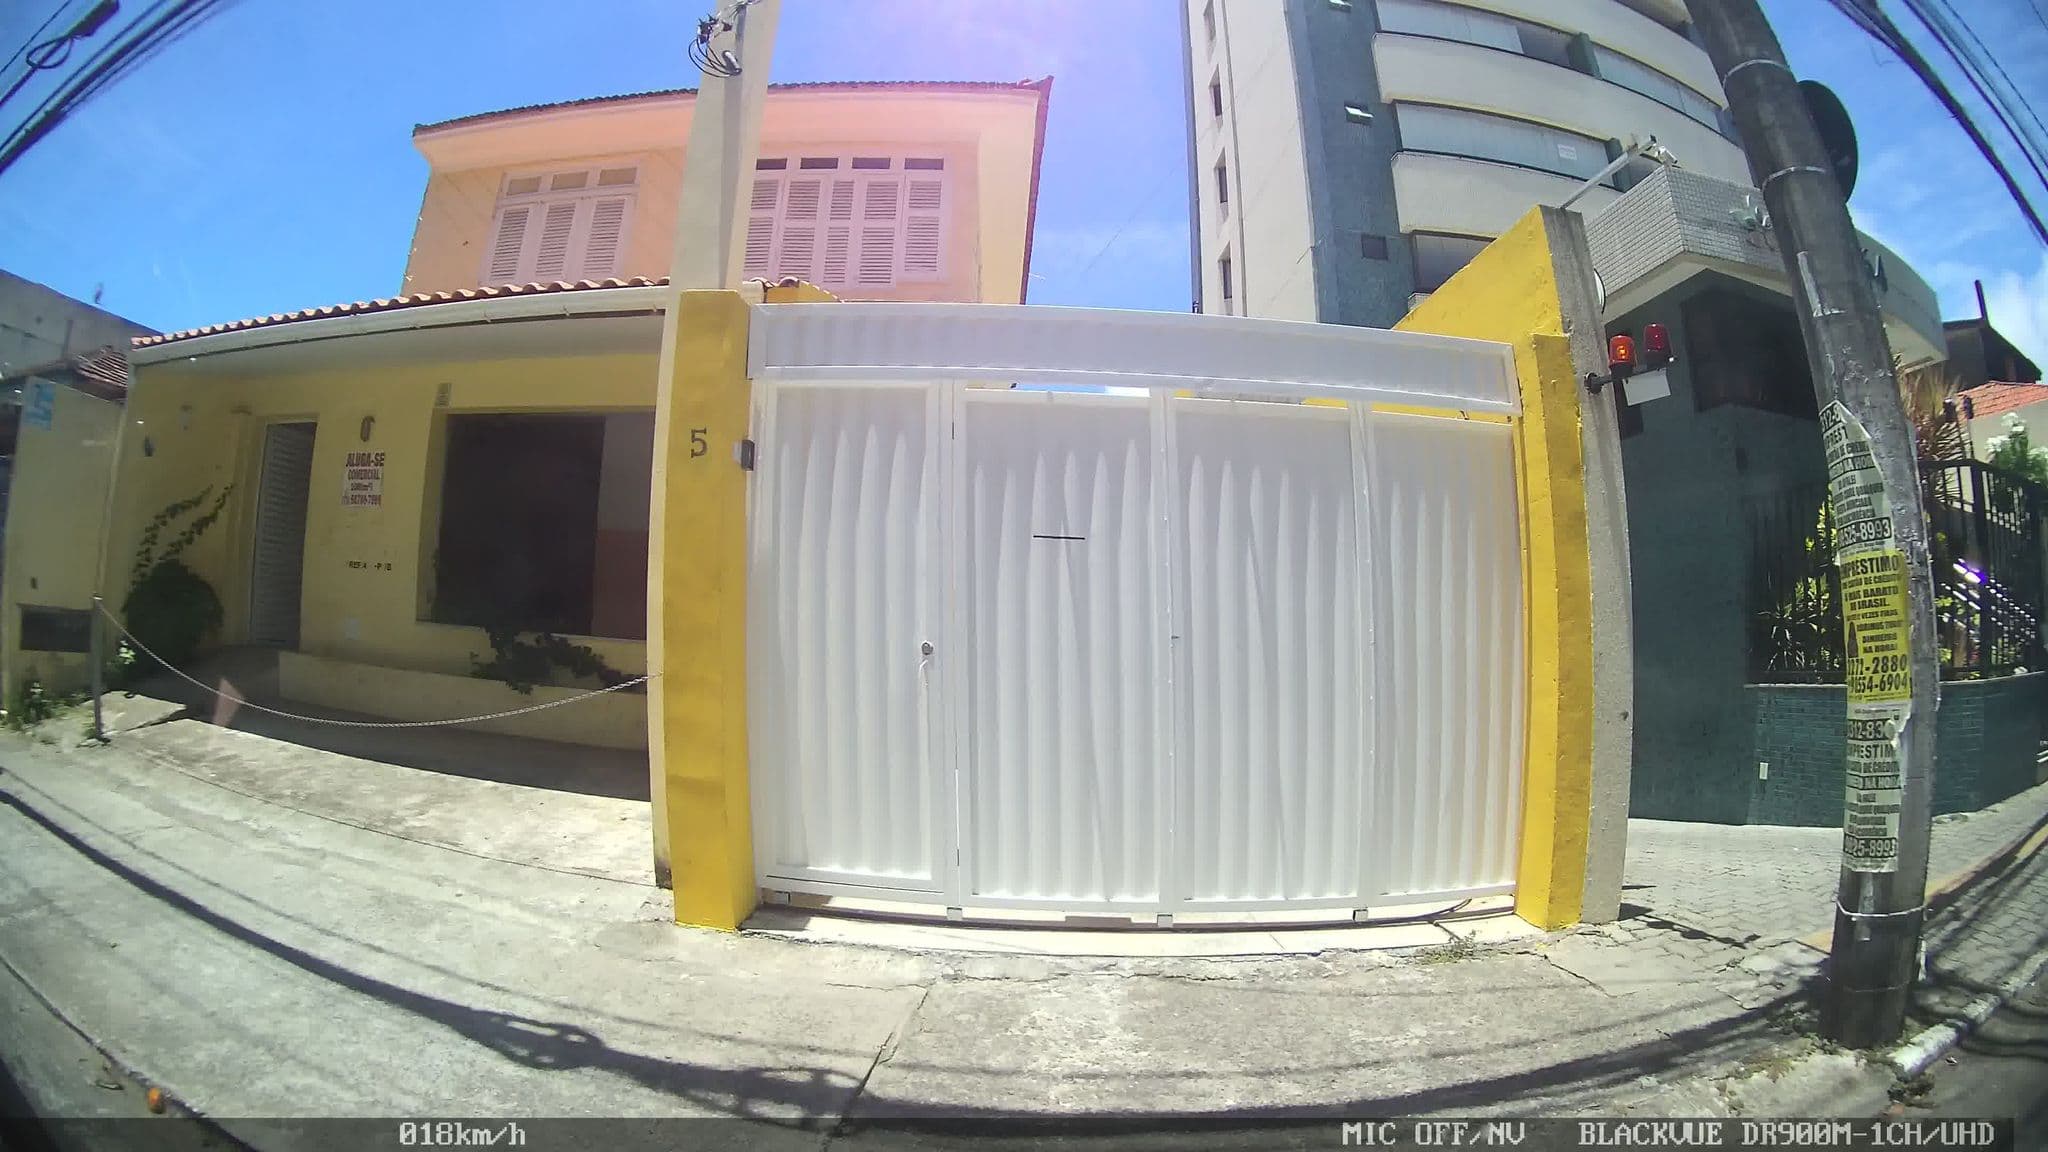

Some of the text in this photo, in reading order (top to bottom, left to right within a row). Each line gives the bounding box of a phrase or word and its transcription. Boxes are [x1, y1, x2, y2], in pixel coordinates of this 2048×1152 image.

[691, 428, 707, 458] 5
[346, 452, 385, 467] ALUGA-SE
[348, 468, 381, 481] COMERCIAL
[1862, 585, 1899, 598] BARATO
